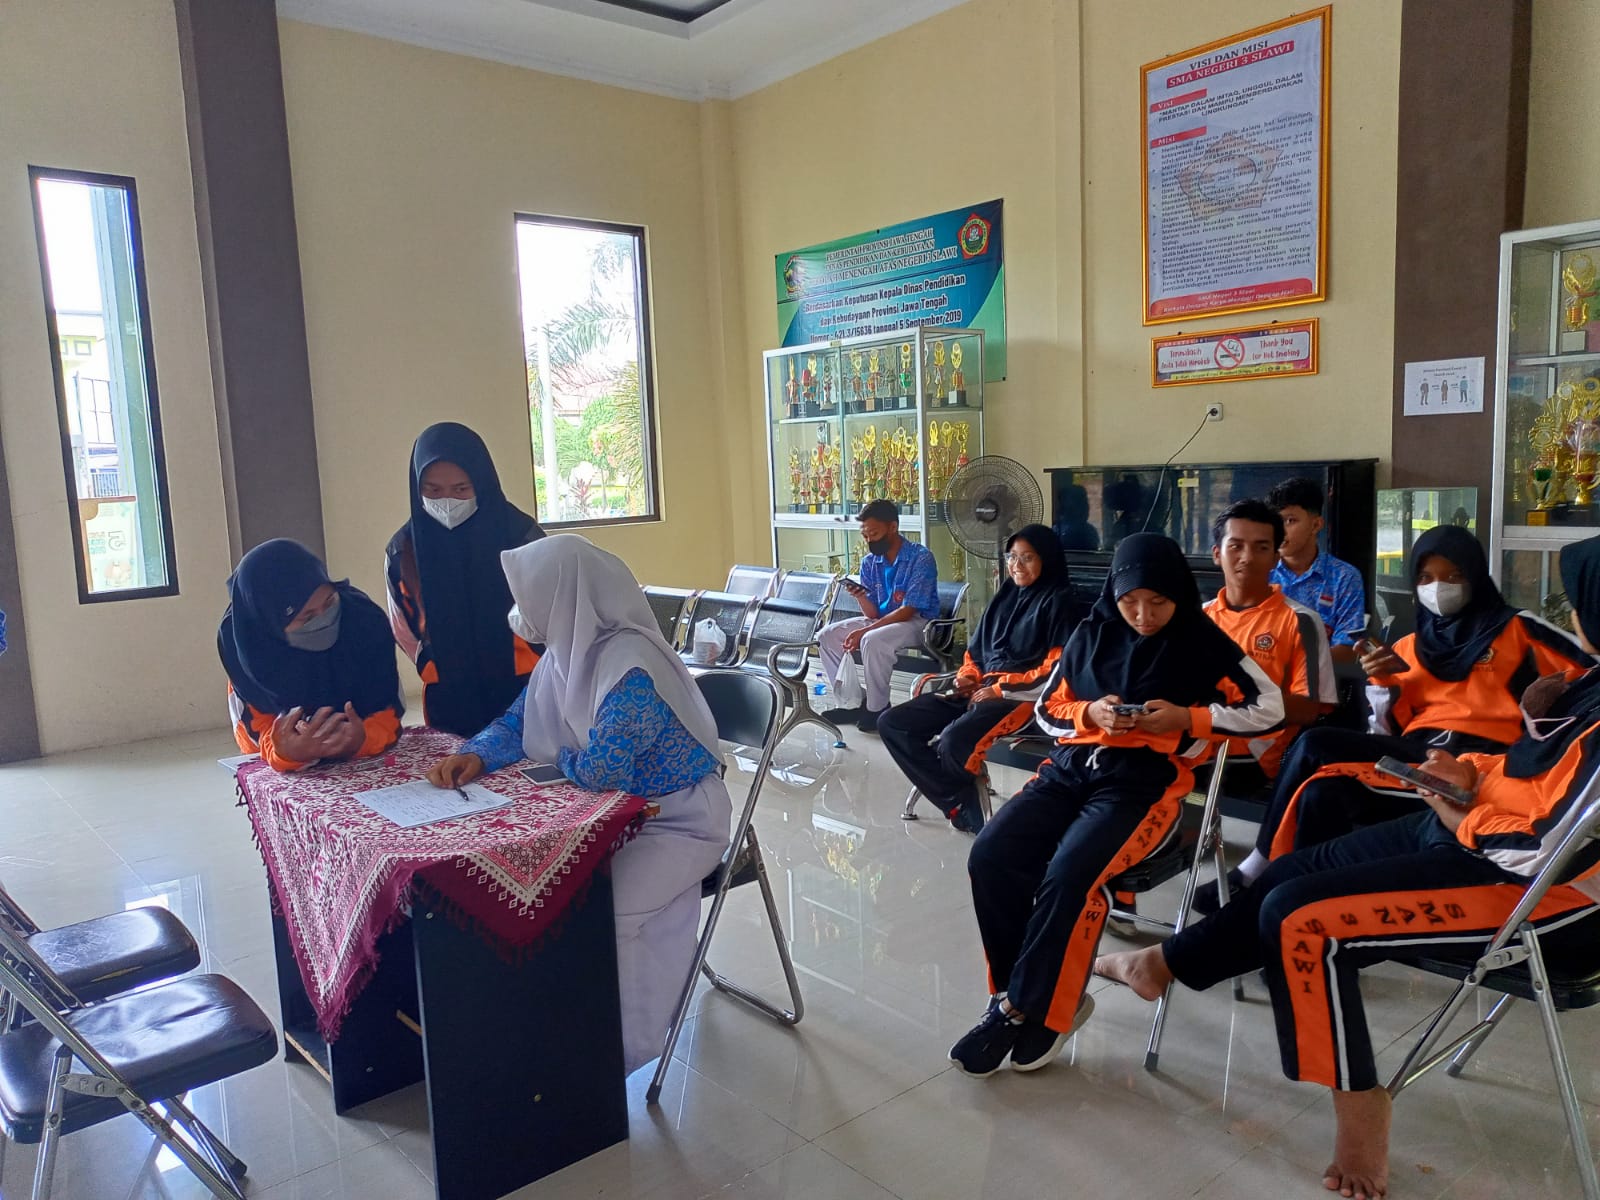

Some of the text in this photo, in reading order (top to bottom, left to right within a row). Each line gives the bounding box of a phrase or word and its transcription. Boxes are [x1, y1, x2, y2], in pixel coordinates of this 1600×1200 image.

[1169, 42, 1290, 87] SMA NEGERI 3 SLAWI
[1189, 39, 1267, 71] VISI DAN MISI
[1191, 96, 1214, 109] DALAM
[1275, 71, 1302, 85] DALAM
[1192, 104, 1206, 113] DAN
[1208, 97, 1233, 109] MAMPU
[1201, 98, 1248, 116] LINGKUNGAN
[826, 245, 861, 261] PEMERINTAH
[863, 238, 888, 253] PROVINSI
[907, 228, 933, 243] TENGAH
[844, 252, 878, 268] PENDIDIKAN
[892, 239, 934, 257] KEBUDAYAAN
[839, 263, 877, 281] MENENGAH
[879, 259, 895, 272] ATAS
[897, 252, 925, 268] NEGERI
[932, 245, 956, 260] SLAWI
[805, 271, 964, 313] Berdasarkan Keputusan Kepala Dinas Pendidikan
[820, 293, 946, 328] dan Kebudayaan Provinsi Jawa Tengah
[900, 320, 903, 329] 5
[906, 312, 942, 329] September
[945, 310, 961, 322] 2019
[1260, 338, 1278, 348] Thank
[1276, 348, 1299, 359] Smoking
[1373, 901, 1466, 925] SMAN
